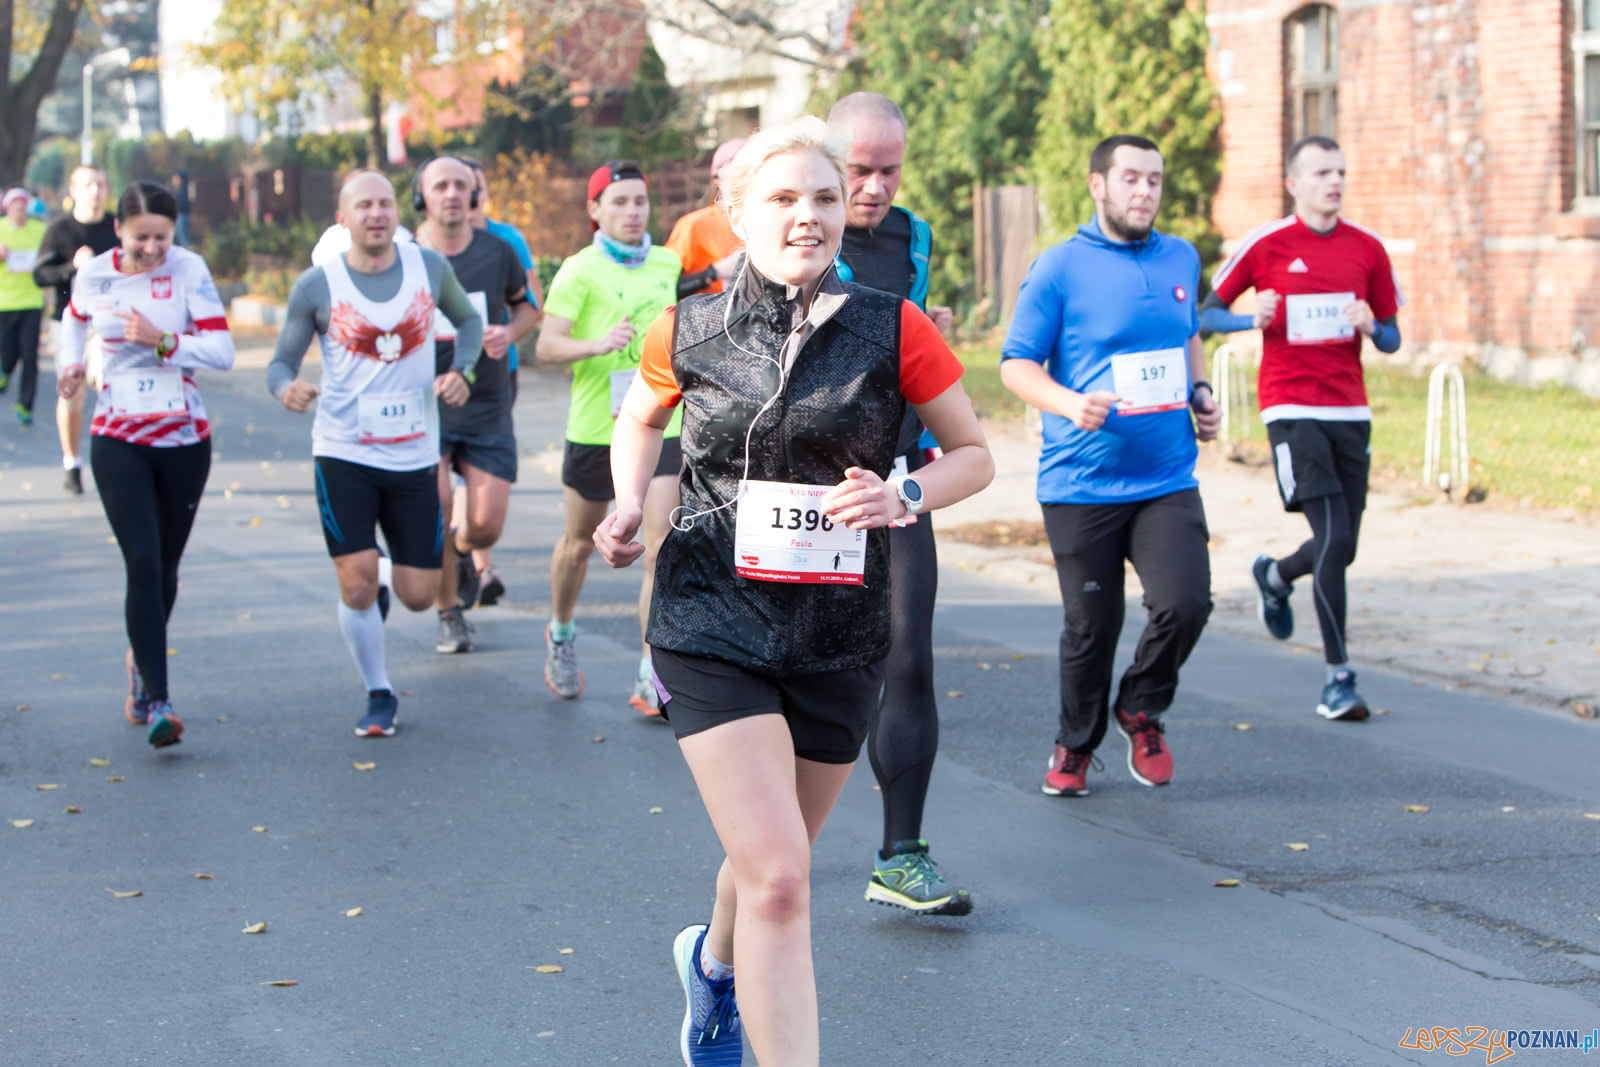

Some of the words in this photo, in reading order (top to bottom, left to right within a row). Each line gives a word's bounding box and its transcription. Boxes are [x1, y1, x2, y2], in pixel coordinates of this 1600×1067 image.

[1140, 365, 1166, 381] 197
[137, 379, 154, 392] 27
[380, 405, 406, 416] 433
[771, 507, 834, 532] 1396
[791, 539, 812, 548] Paula
